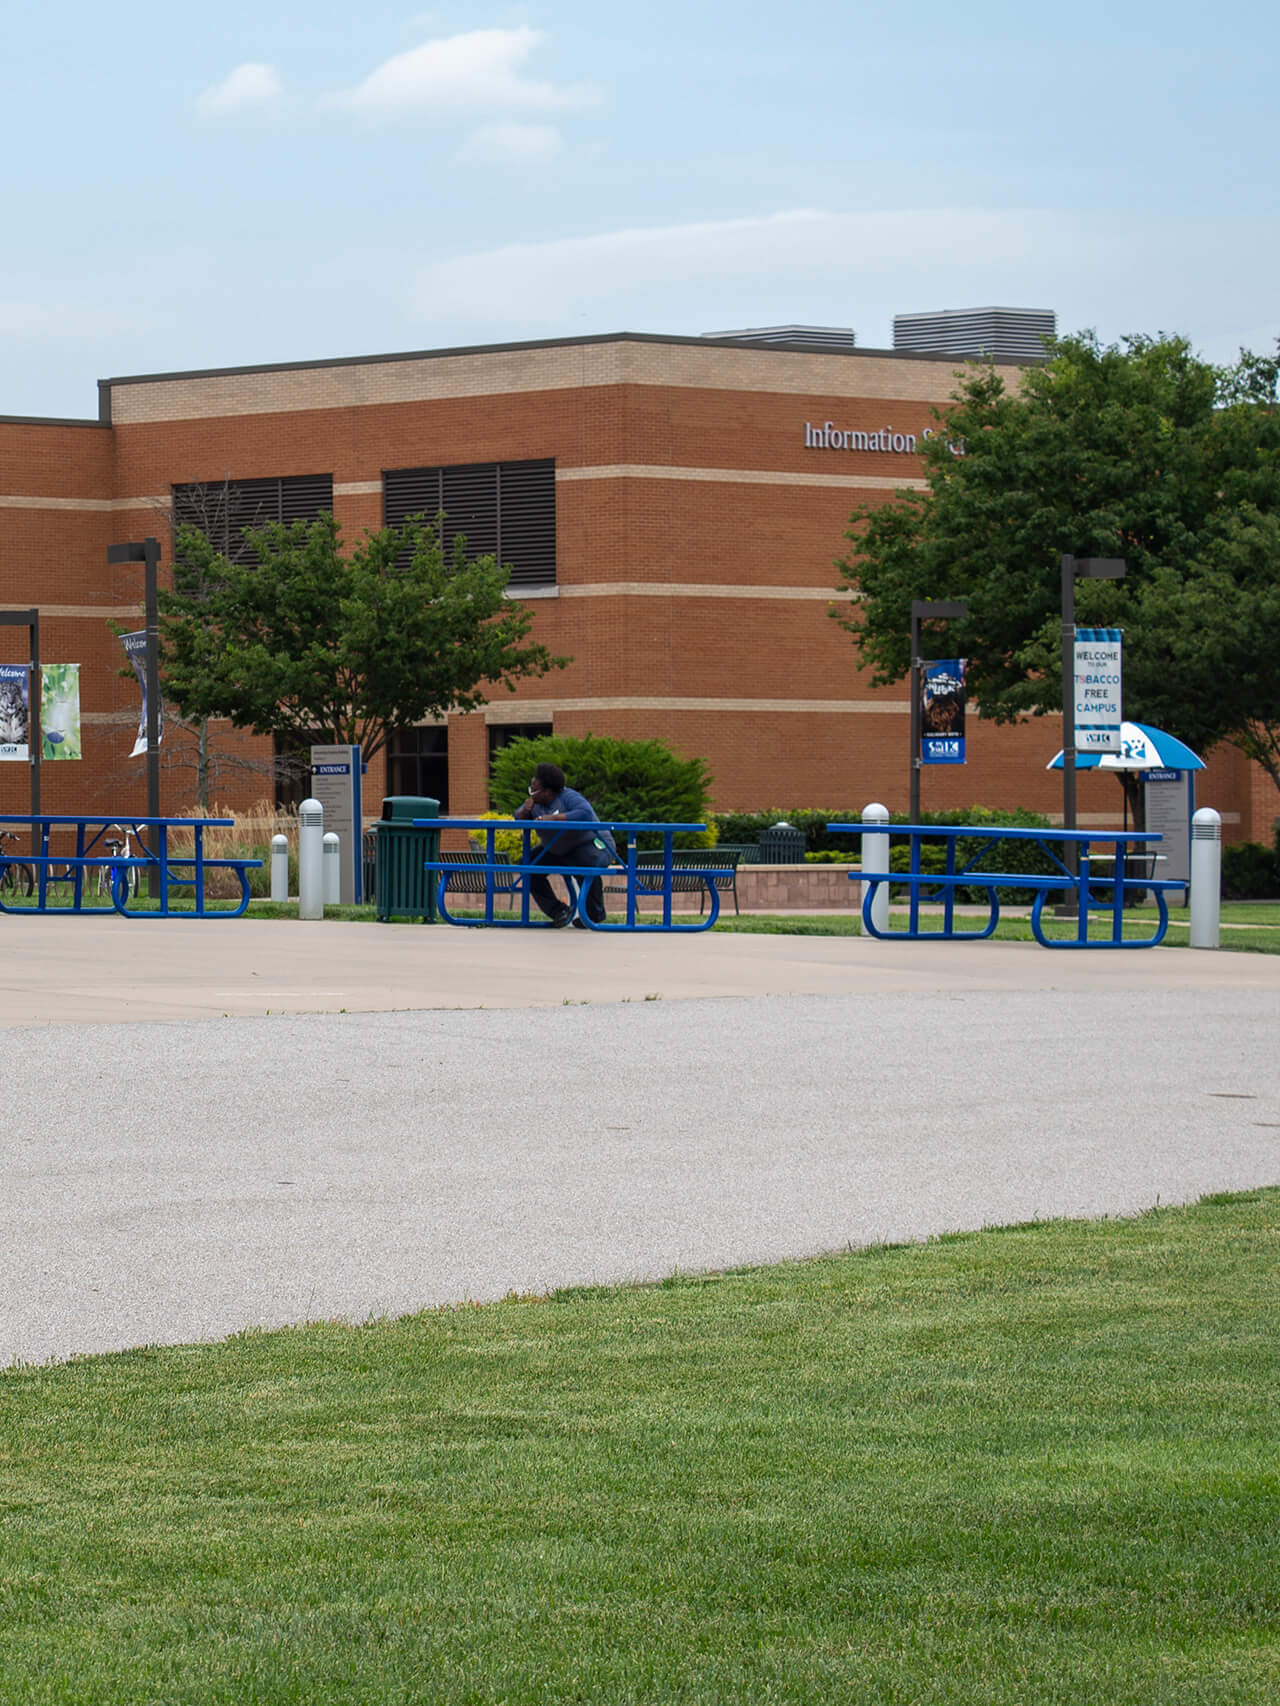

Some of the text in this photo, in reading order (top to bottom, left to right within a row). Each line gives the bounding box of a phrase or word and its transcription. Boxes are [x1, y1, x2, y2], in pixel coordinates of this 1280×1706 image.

[804, 421, 917, 454] Information
[1076, 651, 1119, 661] WELCOME
[1084, 688, 1109, 699] FREE
[1076, 703, 1117, 713] CAMPUS
[320, 765, 347, 773] ENTRANCE
[1148, 772, 1177, 780] ENTRANCE
